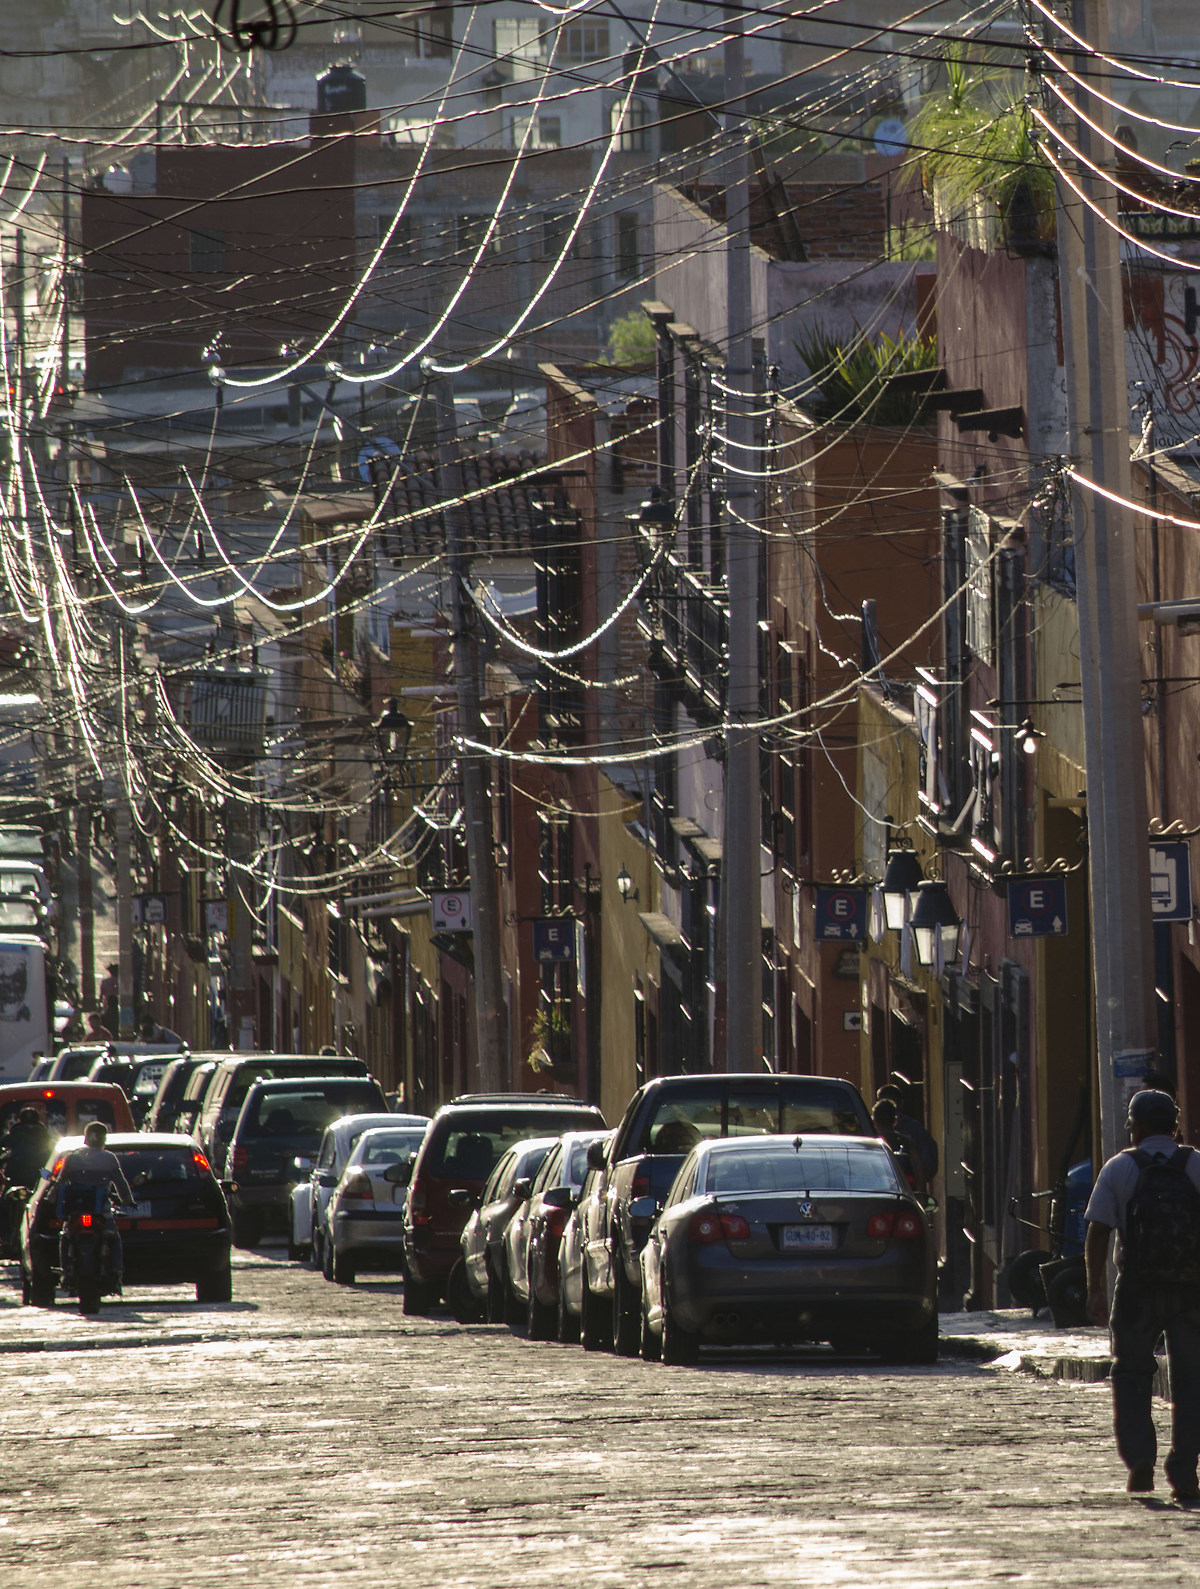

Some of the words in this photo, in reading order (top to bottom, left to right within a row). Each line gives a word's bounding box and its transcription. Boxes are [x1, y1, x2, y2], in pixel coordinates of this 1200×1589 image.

[447, 900, 457, 912] E
[1030, 890, 1044, 908] E
[835, 899, 848, 915] E
[548, 928, 559, 941] E
